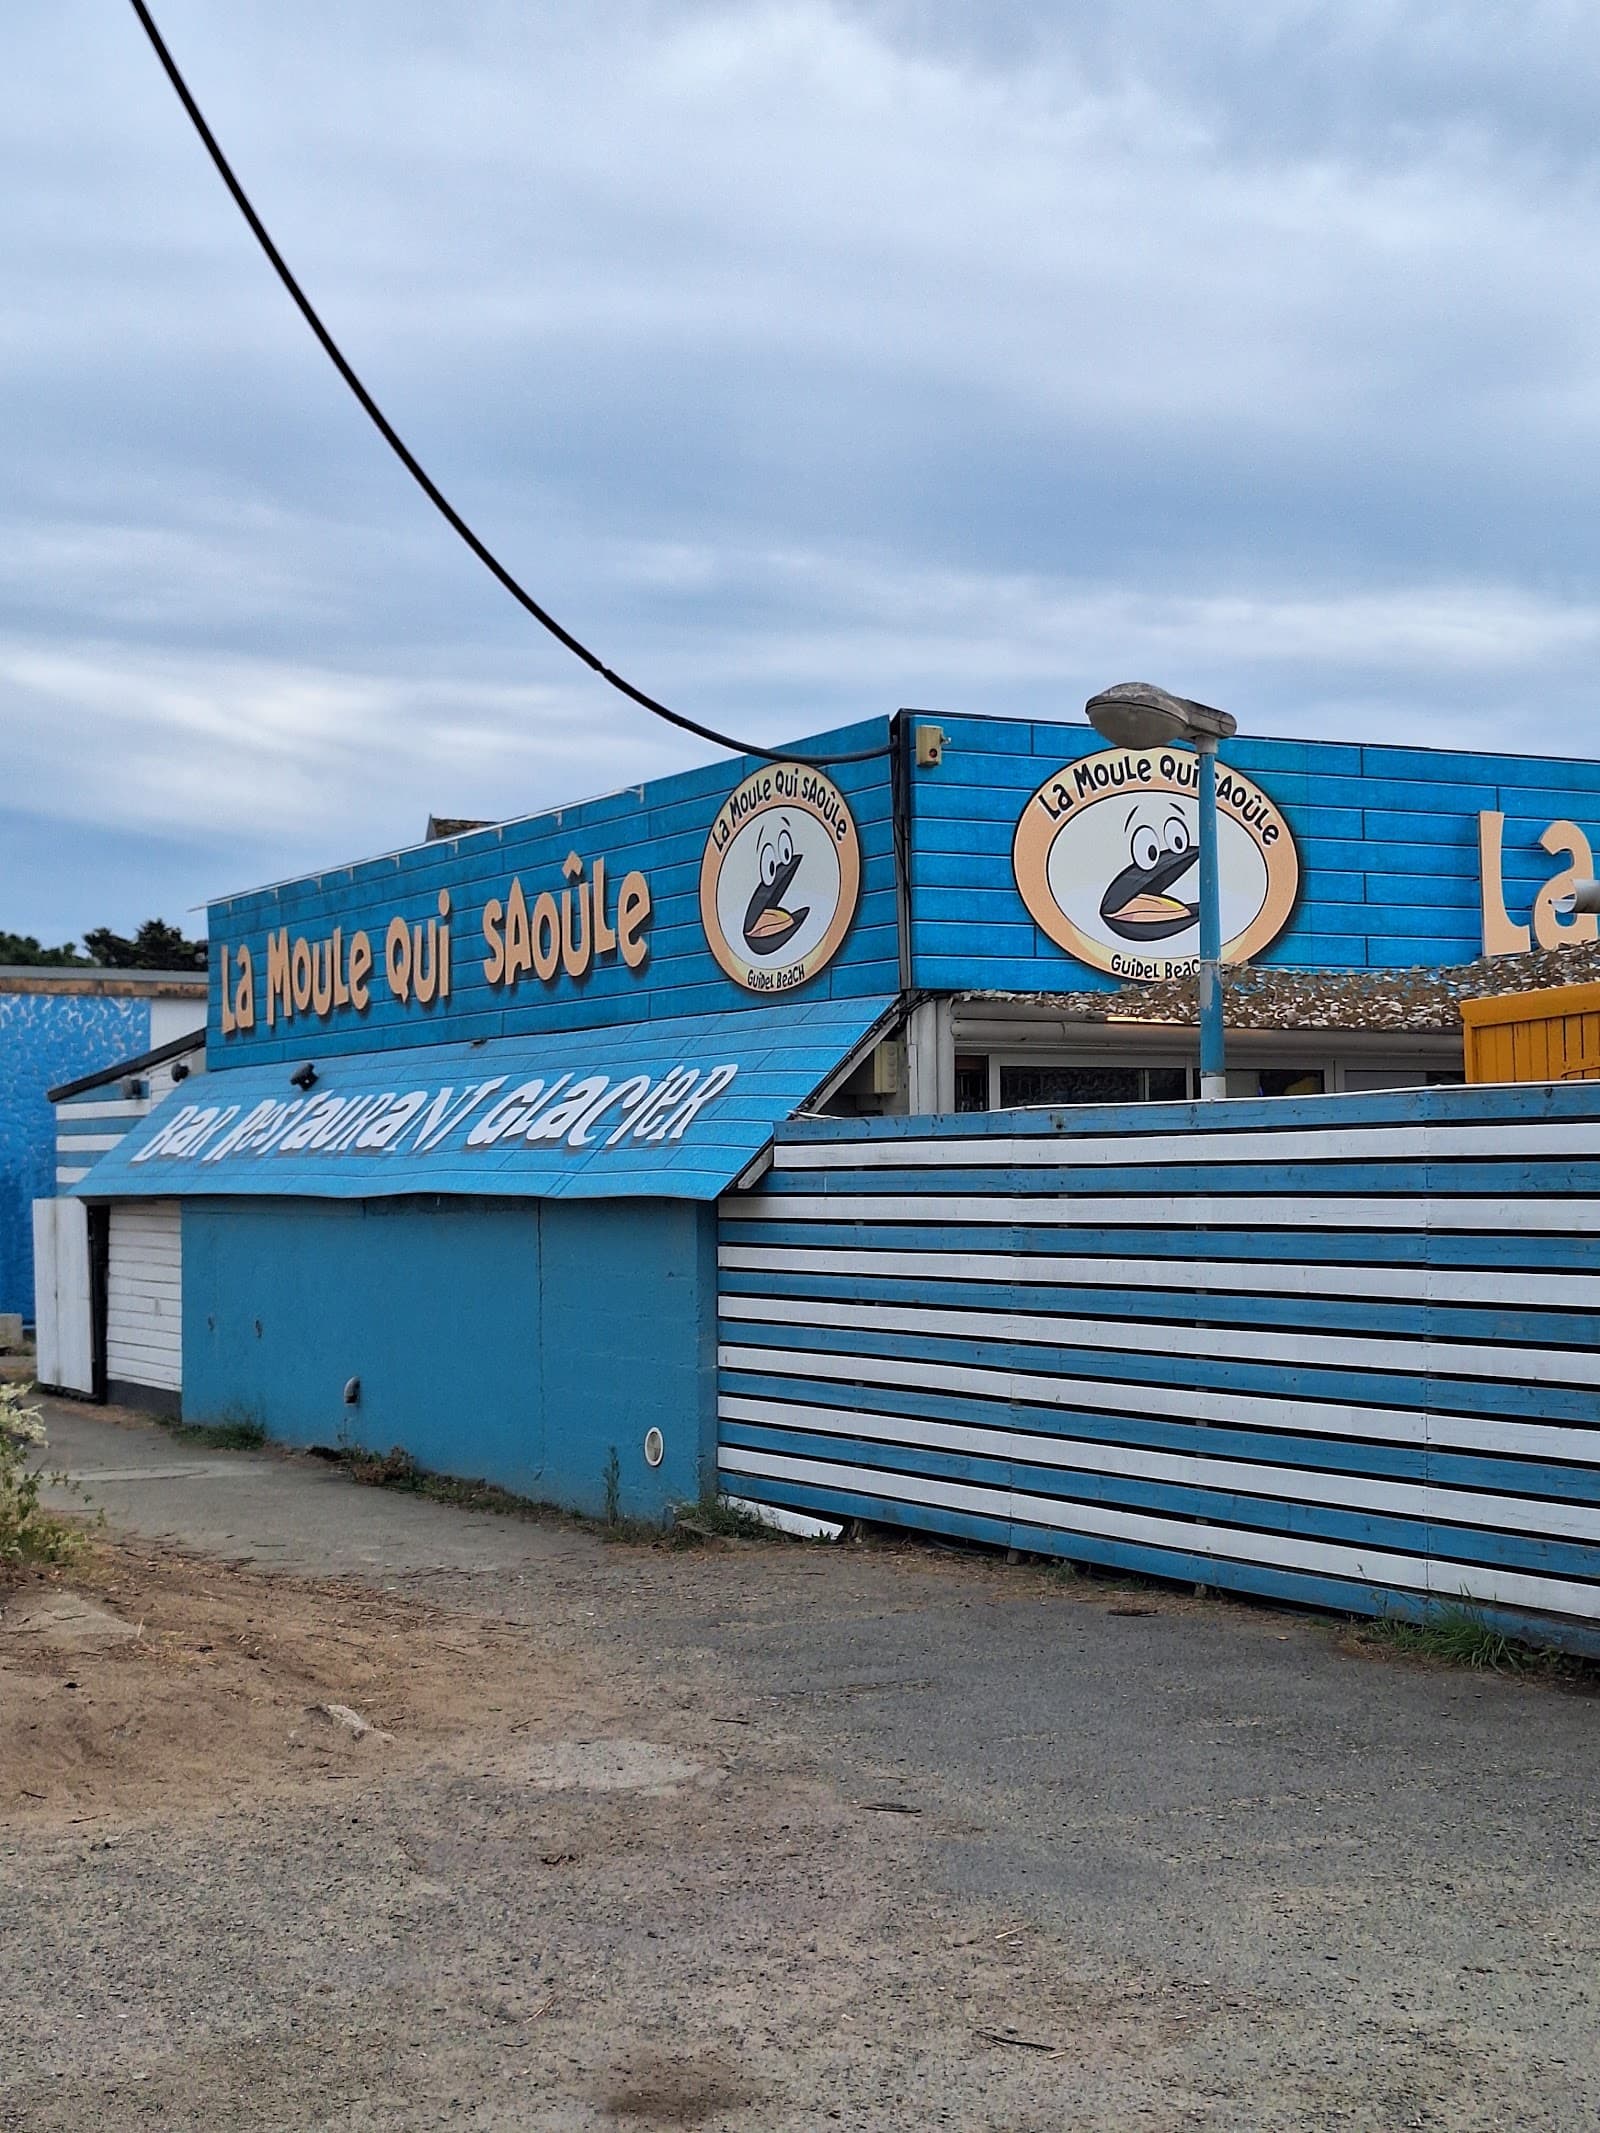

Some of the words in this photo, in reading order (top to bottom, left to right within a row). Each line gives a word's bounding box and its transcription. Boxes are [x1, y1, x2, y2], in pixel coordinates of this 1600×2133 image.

[1038, 783, 1074, 820] La
[712, 818, 731, 852] La
[1479, 811, 1599, 957] La
[221, 944, 254, 1034] La
